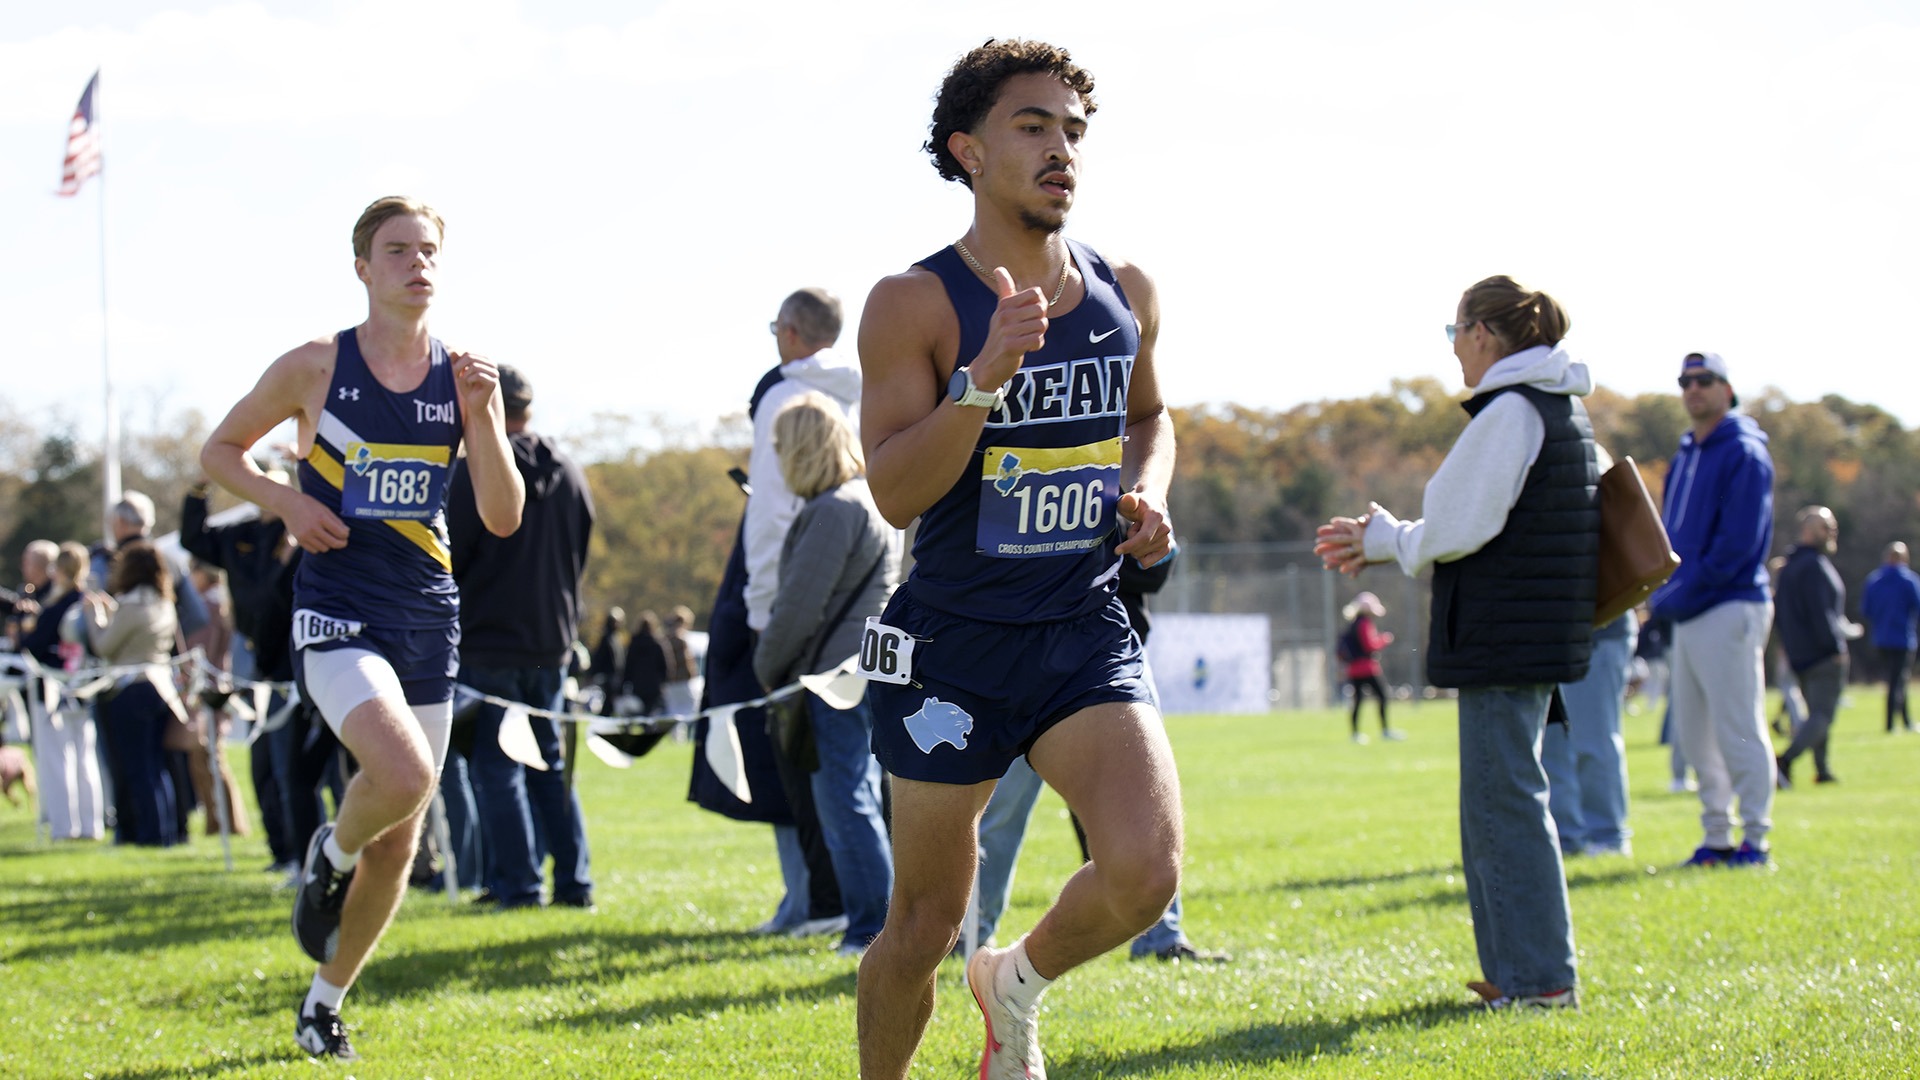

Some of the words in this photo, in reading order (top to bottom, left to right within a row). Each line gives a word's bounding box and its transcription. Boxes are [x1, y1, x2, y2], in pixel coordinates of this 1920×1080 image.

[984, 355, 1134, 428] KEAN
[413, 398, 455, 425] TCNJ
[365, 468, 432, 504] 1683
[1013, 479, 1105, 534] 1606
[998, 543, 1023, 554] CROSS
[1023, 542, 1055, 554] COUNTRY
